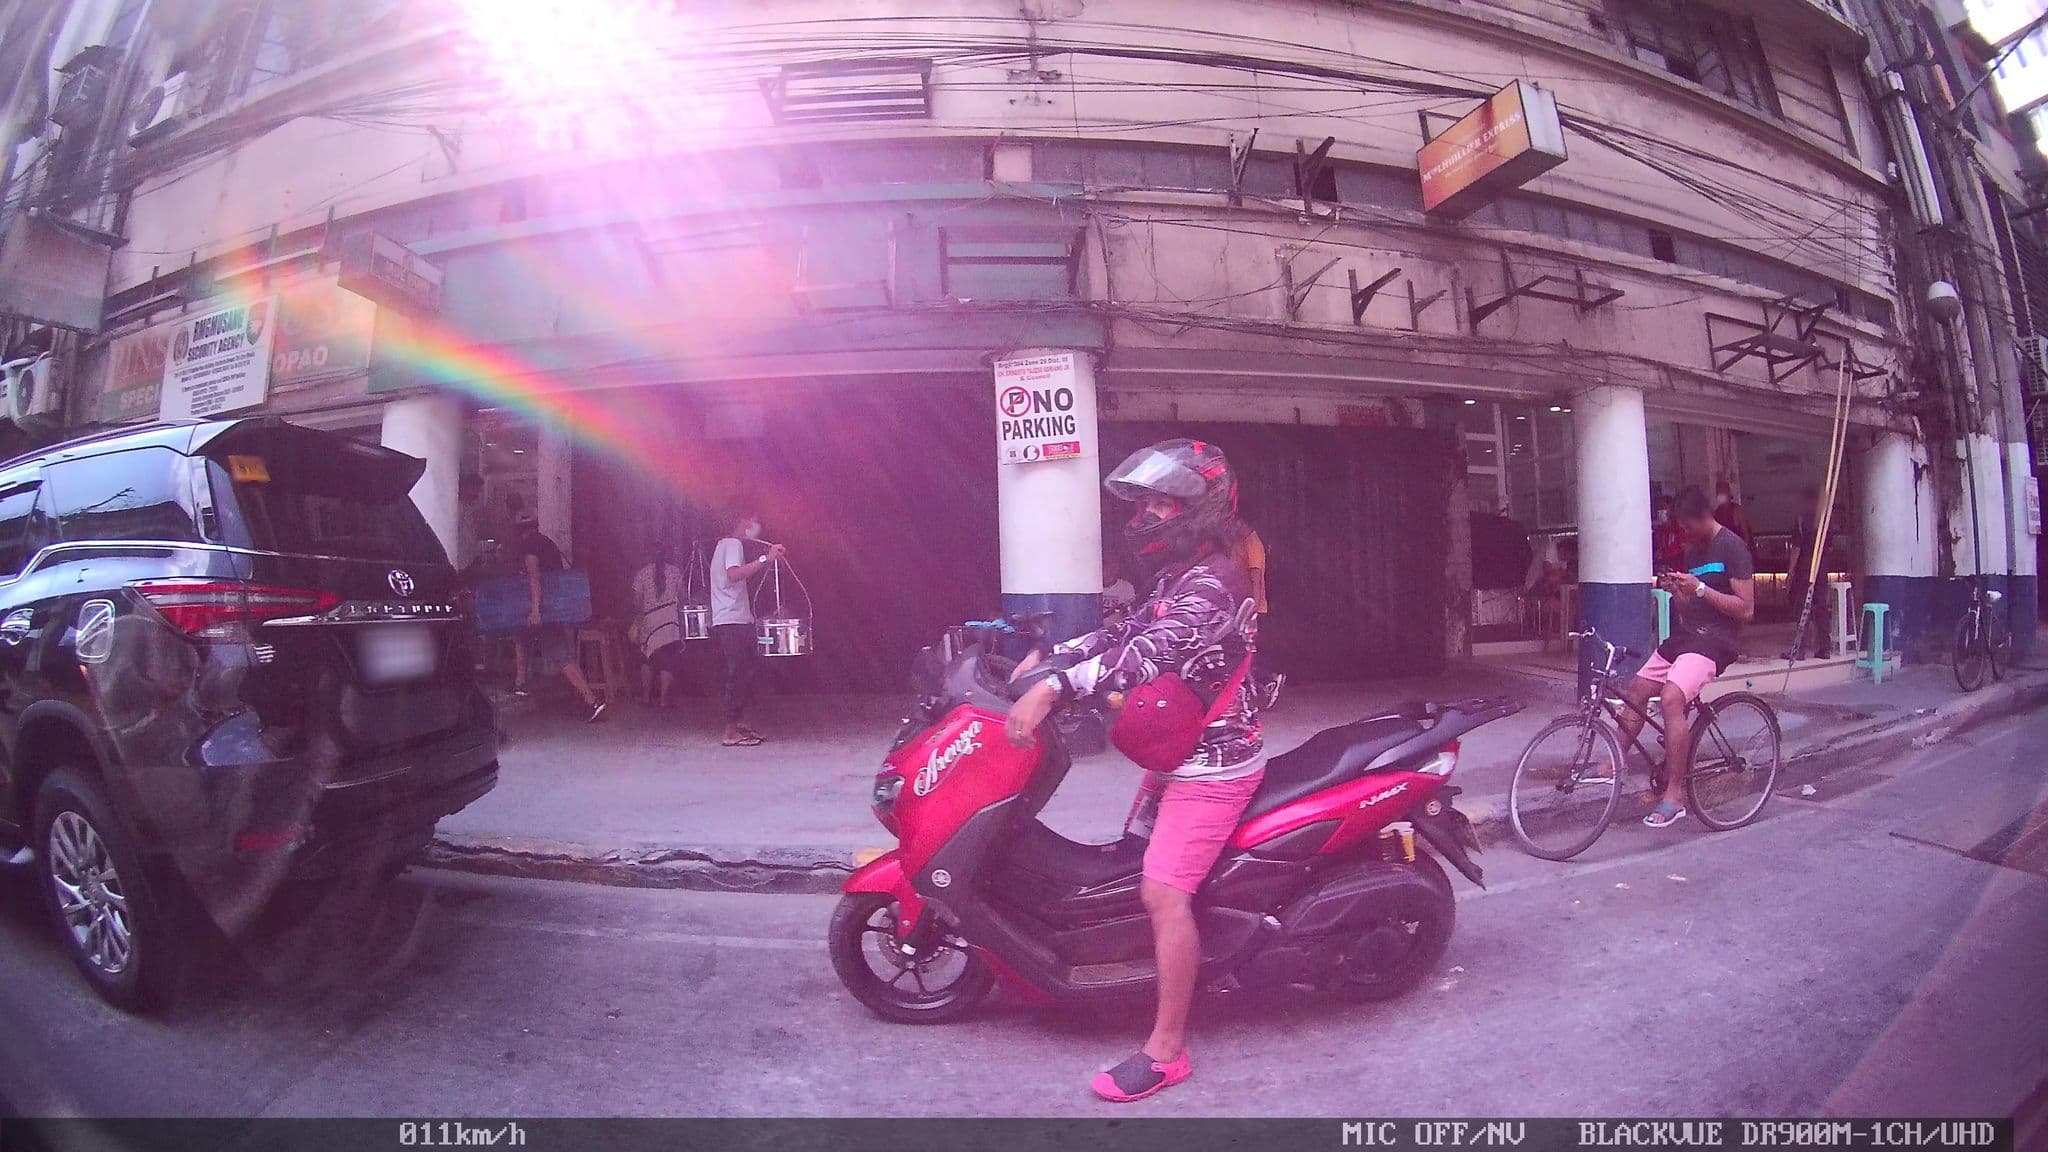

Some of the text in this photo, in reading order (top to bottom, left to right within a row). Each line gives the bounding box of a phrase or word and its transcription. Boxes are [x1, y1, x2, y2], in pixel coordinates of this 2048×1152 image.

[1482, 111, 1522, 143] EXPRESS
[187, 332, 246, 362] SECURITY AGENCY
[1032, 387, 1074, 414] NO
[1002, 414, 1076, 441] PARKING
